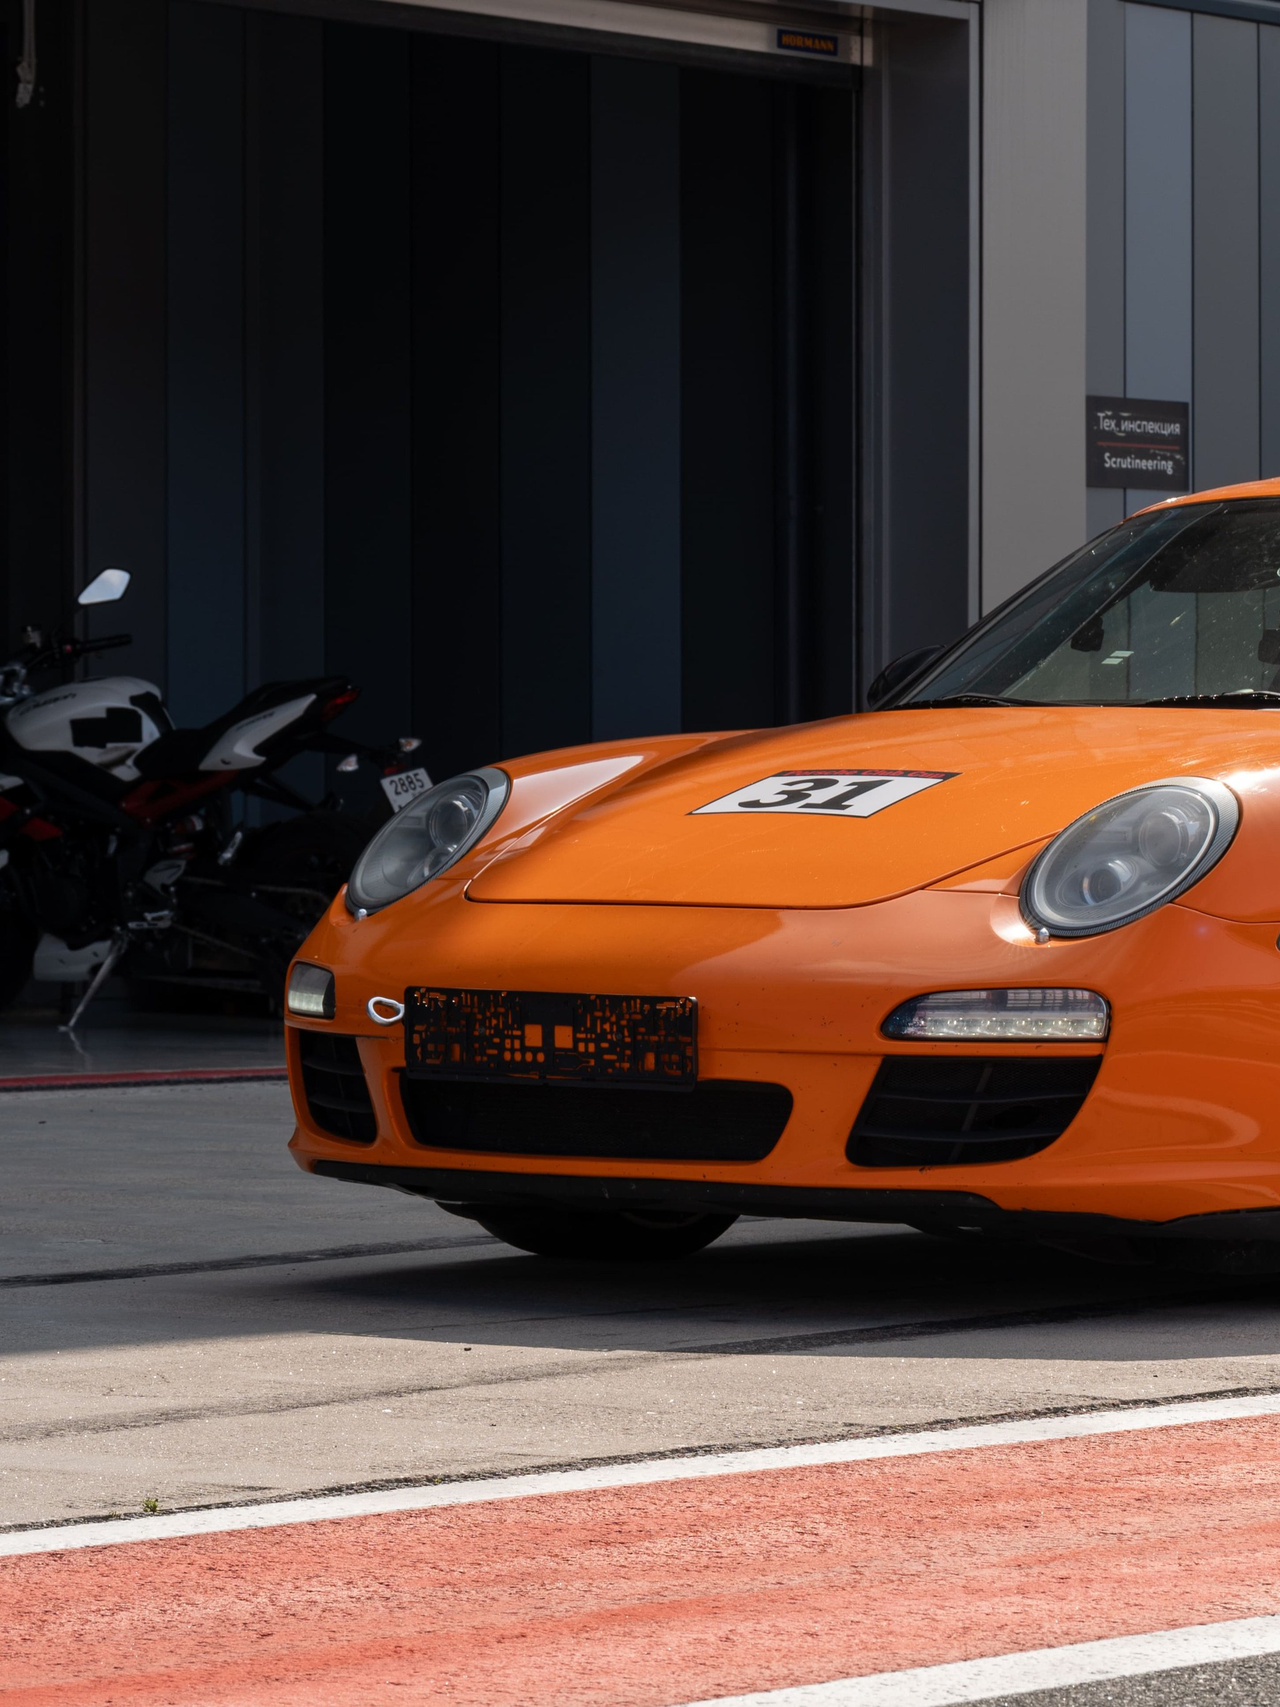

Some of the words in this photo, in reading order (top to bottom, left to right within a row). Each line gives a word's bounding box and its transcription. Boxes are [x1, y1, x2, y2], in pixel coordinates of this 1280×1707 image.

[1097, 412, 1119, 431] Тех.
[1121, 419, 1181, 436] инспекция
[1104, 452, 1174, 475] Scrutineering
[389, 773, 424, 796] 2885
[907, 771, 946, 779] Cup
[738, 778, 894, 811] 31
